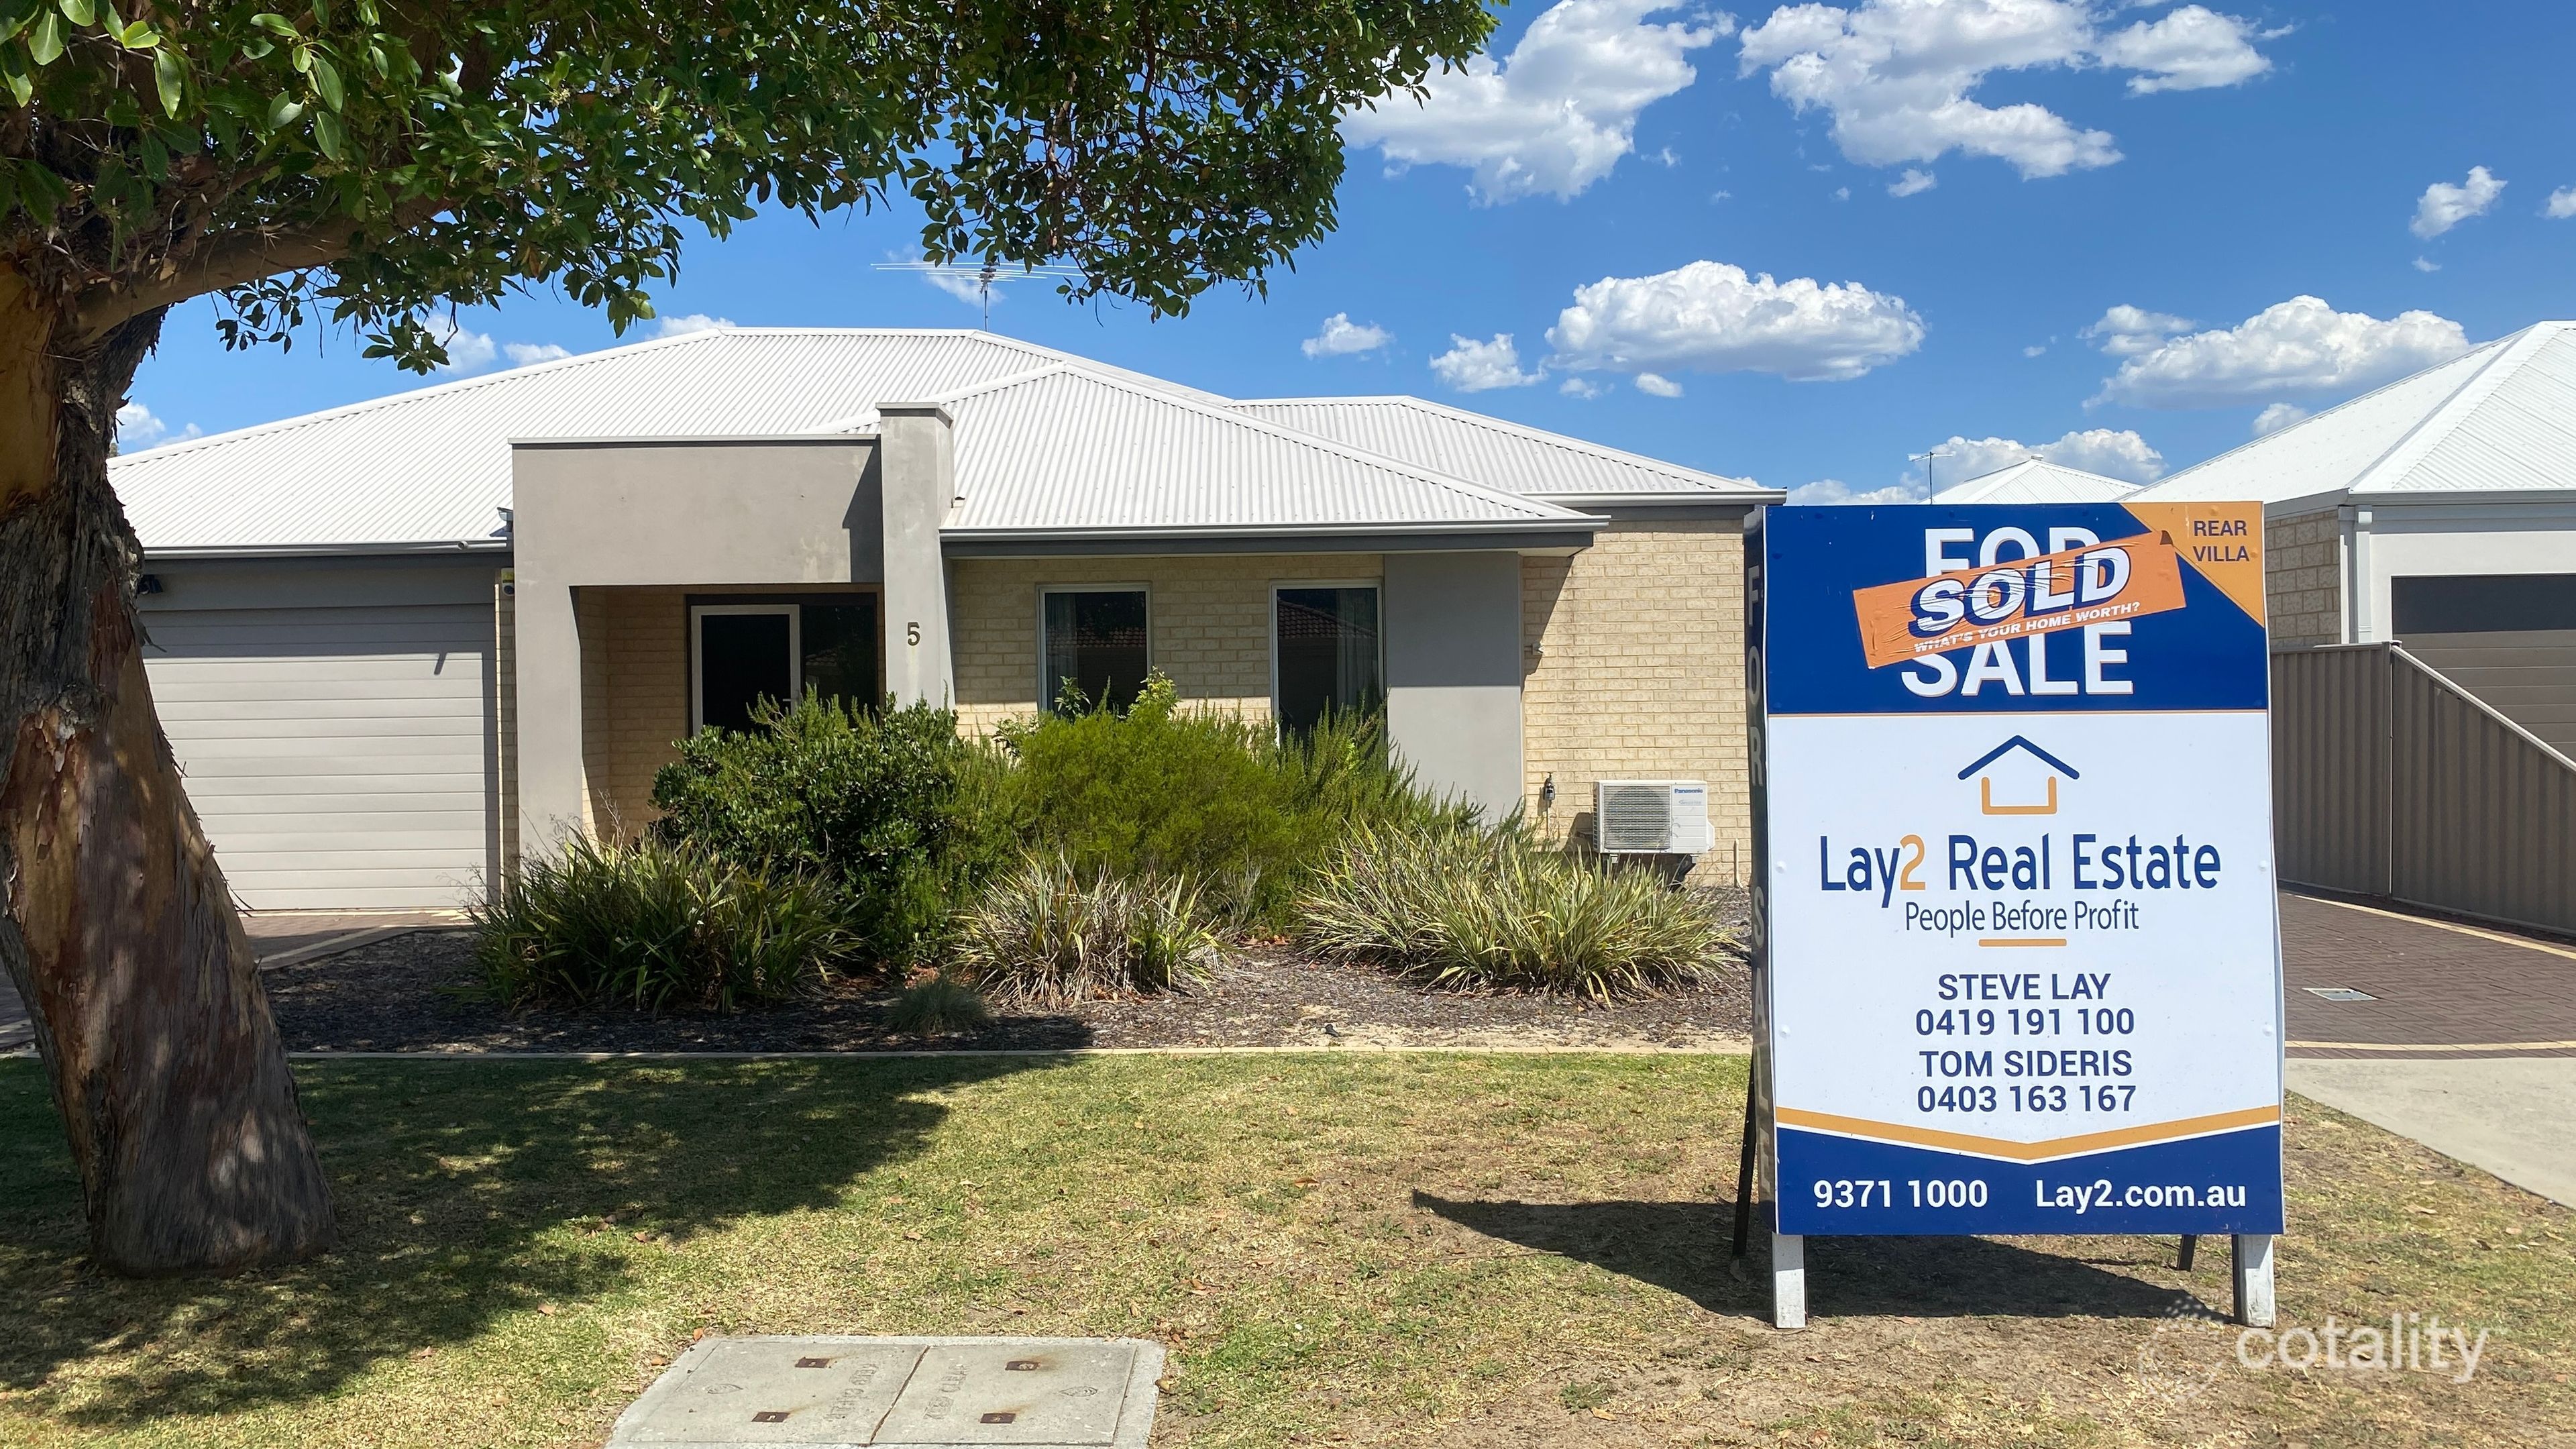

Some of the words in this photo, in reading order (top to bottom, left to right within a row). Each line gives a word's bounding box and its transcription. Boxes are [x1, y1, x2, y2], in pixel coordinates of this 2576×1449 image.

[2194, 521, 2247, 536] REAR
[2193, 546, 2249, 563] VILLA
[1911, 547, 2131, 637] SOLD
[908, 622, 920, 646] 5
[1914, 631, 1974, 653] WHAT'S
[1979, 624, 2021, 639] YOUR
[2026, 614, 2072, 631] HOME
[2076, 602, 2141, 622] WORTH?
[1901, 621, 2134, 697] SALE
[1747, 566, 1764, 786] FOR
[1821, 835, 1925, 908] Lay2
[1949, 833, 2049, 890] Real
[2074, 834, 2221, 890] Estate
[1907, 900, 1985, 938] People
[1993, 900, 2067, 930] Before
[2075, 899, 2139, 929] Profit
[1939, 974, 2040, 1000] STEVE
[2052, 973, 2110, 1000] LAY
[1917, 1010, 1994, 1036] 0419
[2008, 1009, 2060, 1035] 191
[2078, 1008, 2135, 1034] 100
[1919, 1051, 1992, 1077] TOM
[2004, 1050, 2132, 1077] SIDERIS
[1918, 1086, 1997, 1112] 0403
[2010, 1085, 2066, 1112] 163
[2080, 1085, 2136, 1112] 167
[1814, 1180, 1890, 1208] 9371
[1909, 1180, 1988, 1208] 1000
[2037, 1179, 2246, 1214] Lay2.com.au
